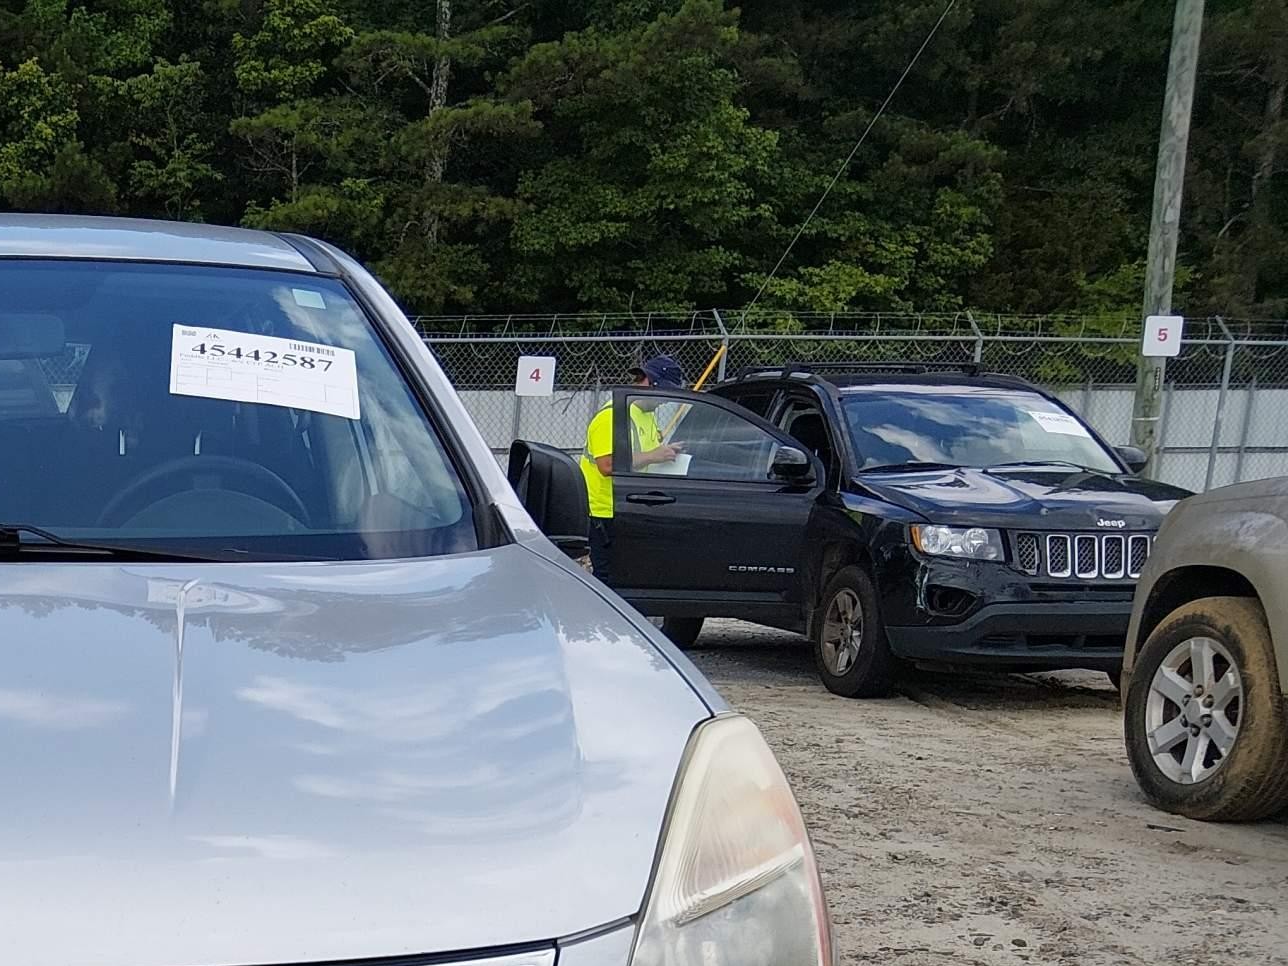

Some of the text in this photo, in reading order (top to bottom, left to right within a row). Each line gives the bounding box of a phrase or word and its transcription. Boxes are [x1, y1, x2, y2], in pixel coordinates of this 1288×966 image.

[1157, 327, 1169, 342] 5
[191, 343, 334, 373] 45442587
[529, 367, 542, 382] 4
[1096, 517, 1127, 529] Jeep
[728, 565, 795, 574] COMPASS
